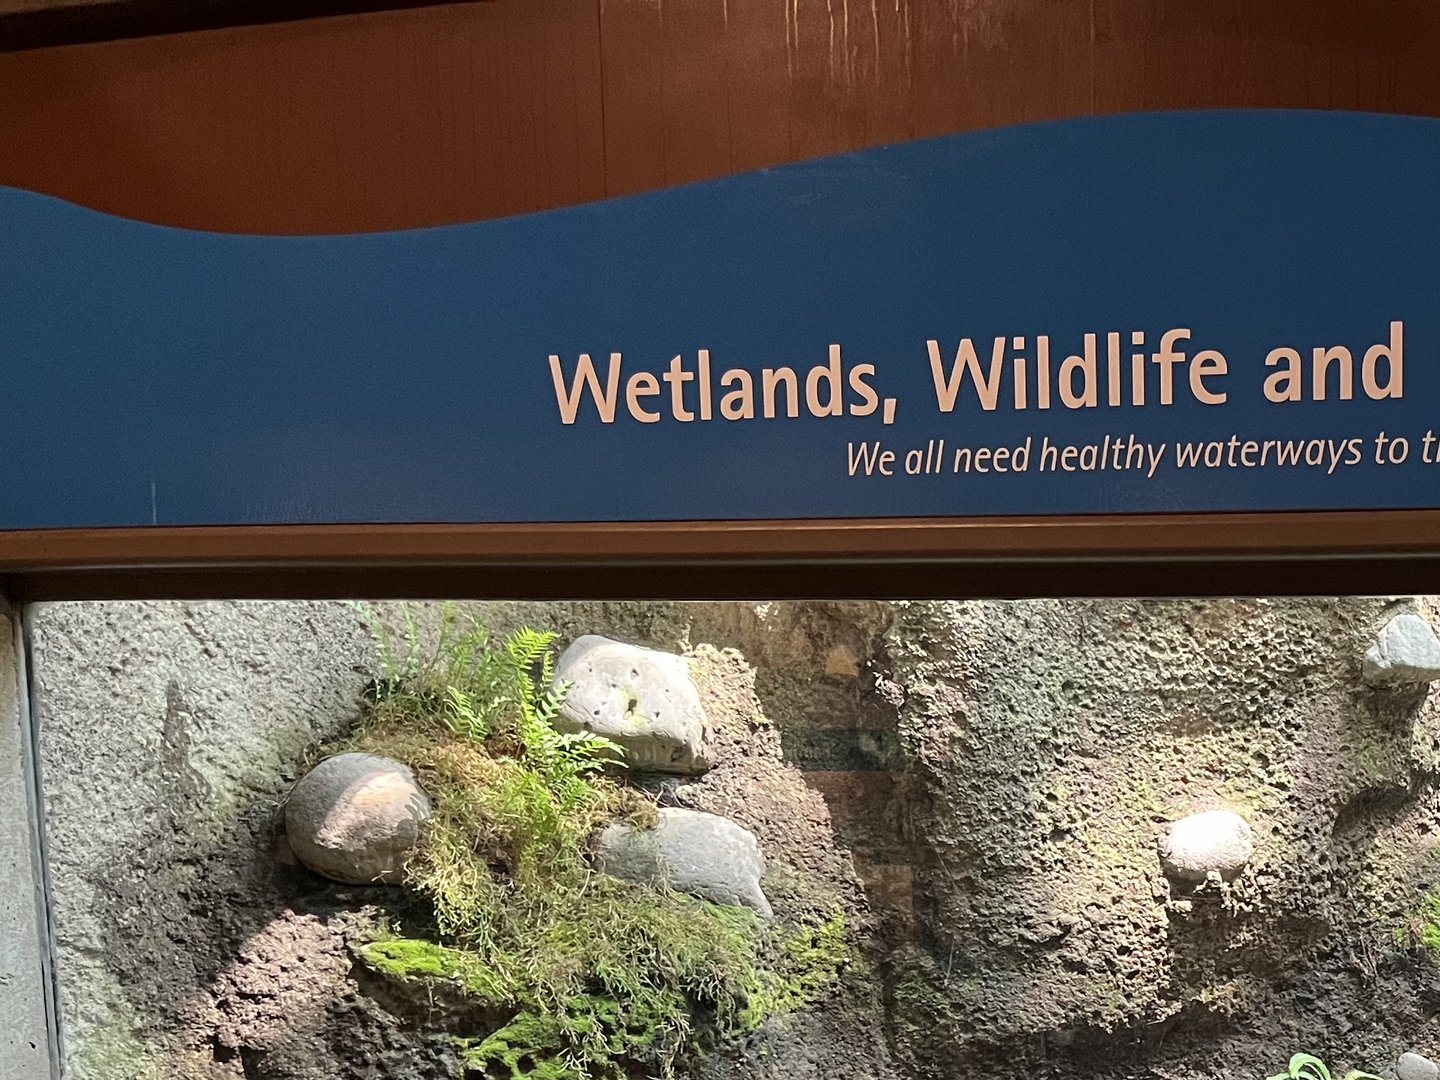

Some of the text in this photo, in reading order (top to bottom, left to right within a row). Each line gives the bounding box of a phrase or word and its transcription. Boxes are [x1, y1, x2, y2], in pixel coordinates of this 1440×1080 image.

[548, 344, 898, 425] Wetlands,
[926, 328, 1228, 412] Wildlife
[1262, 320, 1403, 402] and
[847, 441, 895, 476] We
[904, 439, 945, 474] all
[953, 437, 1032, 473] need
[1037, 434, 1166, 477] healthy
[1175, 434, 1363, 474] waterways
[1374, 431, 1409, 465] to
